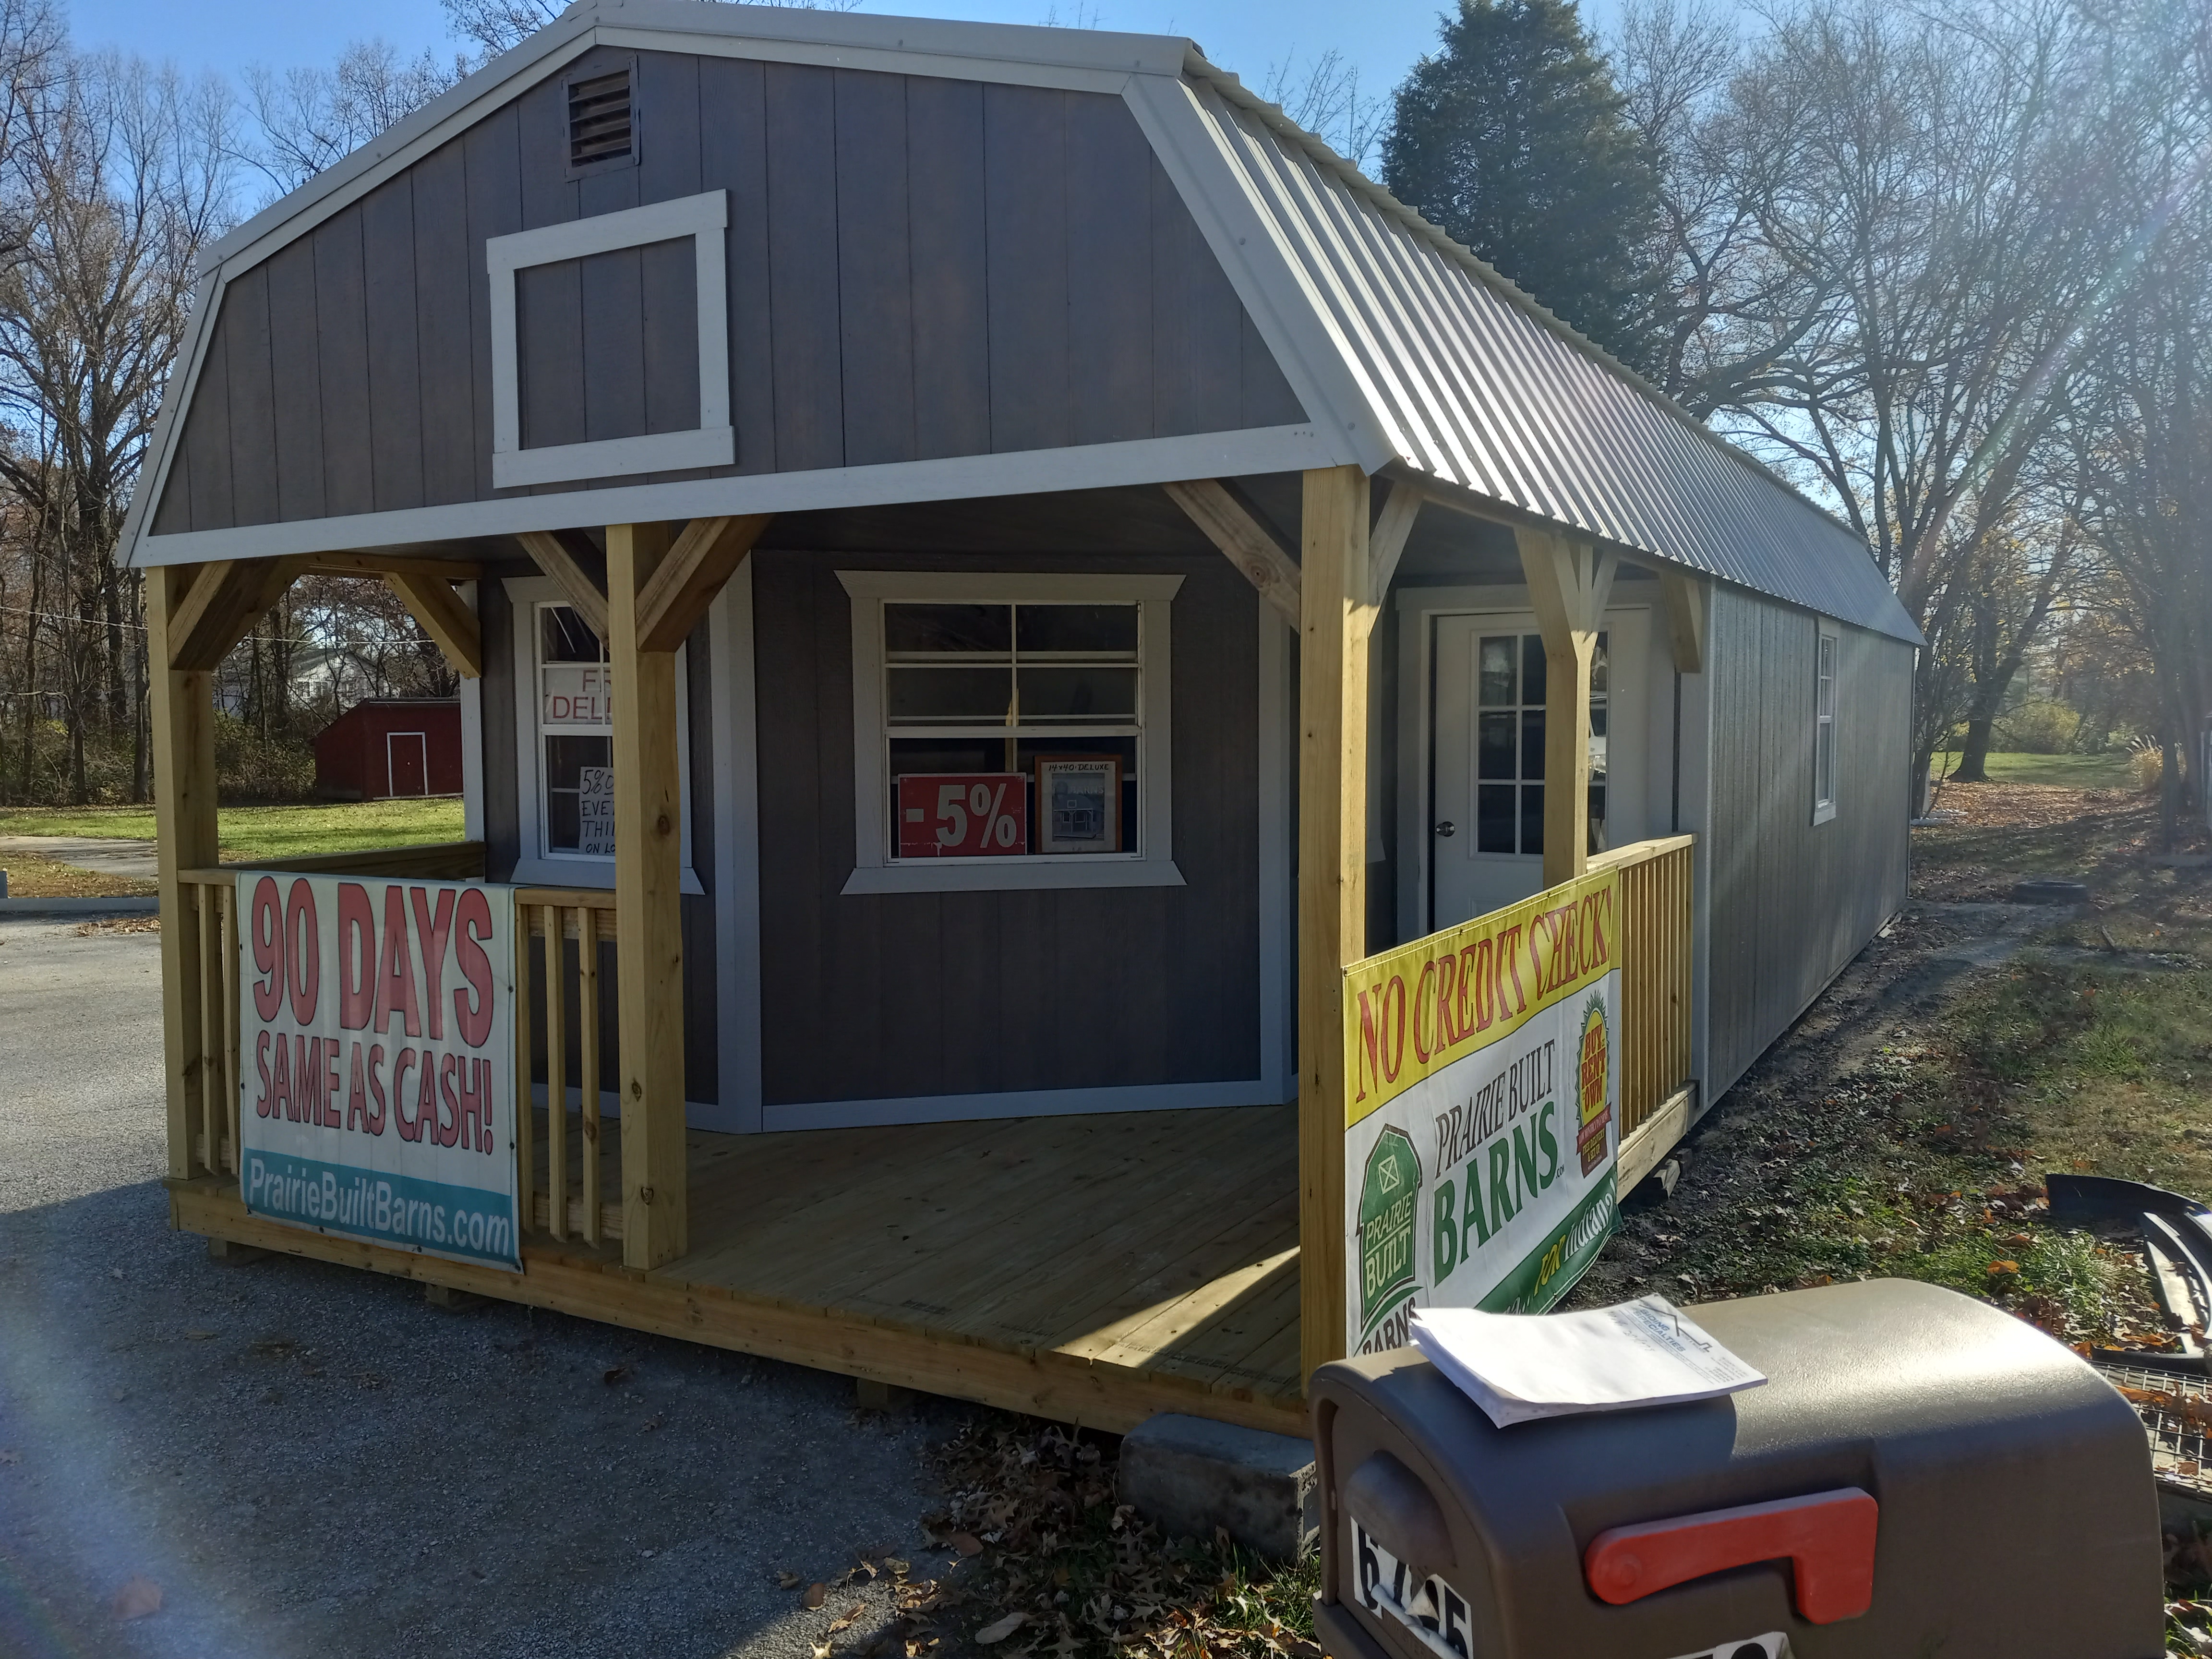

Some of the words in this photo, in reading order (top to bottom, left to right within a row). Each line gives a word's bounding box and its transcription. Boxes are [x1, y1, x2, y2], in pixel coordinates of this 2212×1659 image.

[582, 769, 604, 794] 5%
[581, 800, 614, 817] EVE
[586, 843, 600, 854] ON
[251, 875, 319, 1026] 90
[337, 882, 494, 1048] DAYS
[1356, 975, 1406, 1104] NO
[1414, 923, 1527, 1065] CREDIT
[1581, 1046, 1606, 1090] RENT
[1585, 1023, 1603, 1061] BUY
[256, 1029, 341, 1129] SAME
[347, 1041, 385, 1137] AS
[393, 1047, 493, 1156] CASH!
[1435, 1071, 1506, 1180] PRAIRIE
[1508, 1038, 1555, 1122] BUILT
[1585, 1075, 1603, 1113] OWN
[250, 1157, 510, 1257] PrairieBuiltBarns.com
[1366, 1190, 1413, 1251] PRAIRIE
[1434, 1101, 1559, 1289] BARNS
[1365, 1225, 1411, 1299] BUILT
[1633, 1310, 1686, 1353] SPECIALTIES
[1640, 1309, 1671, 1331] SIDING
